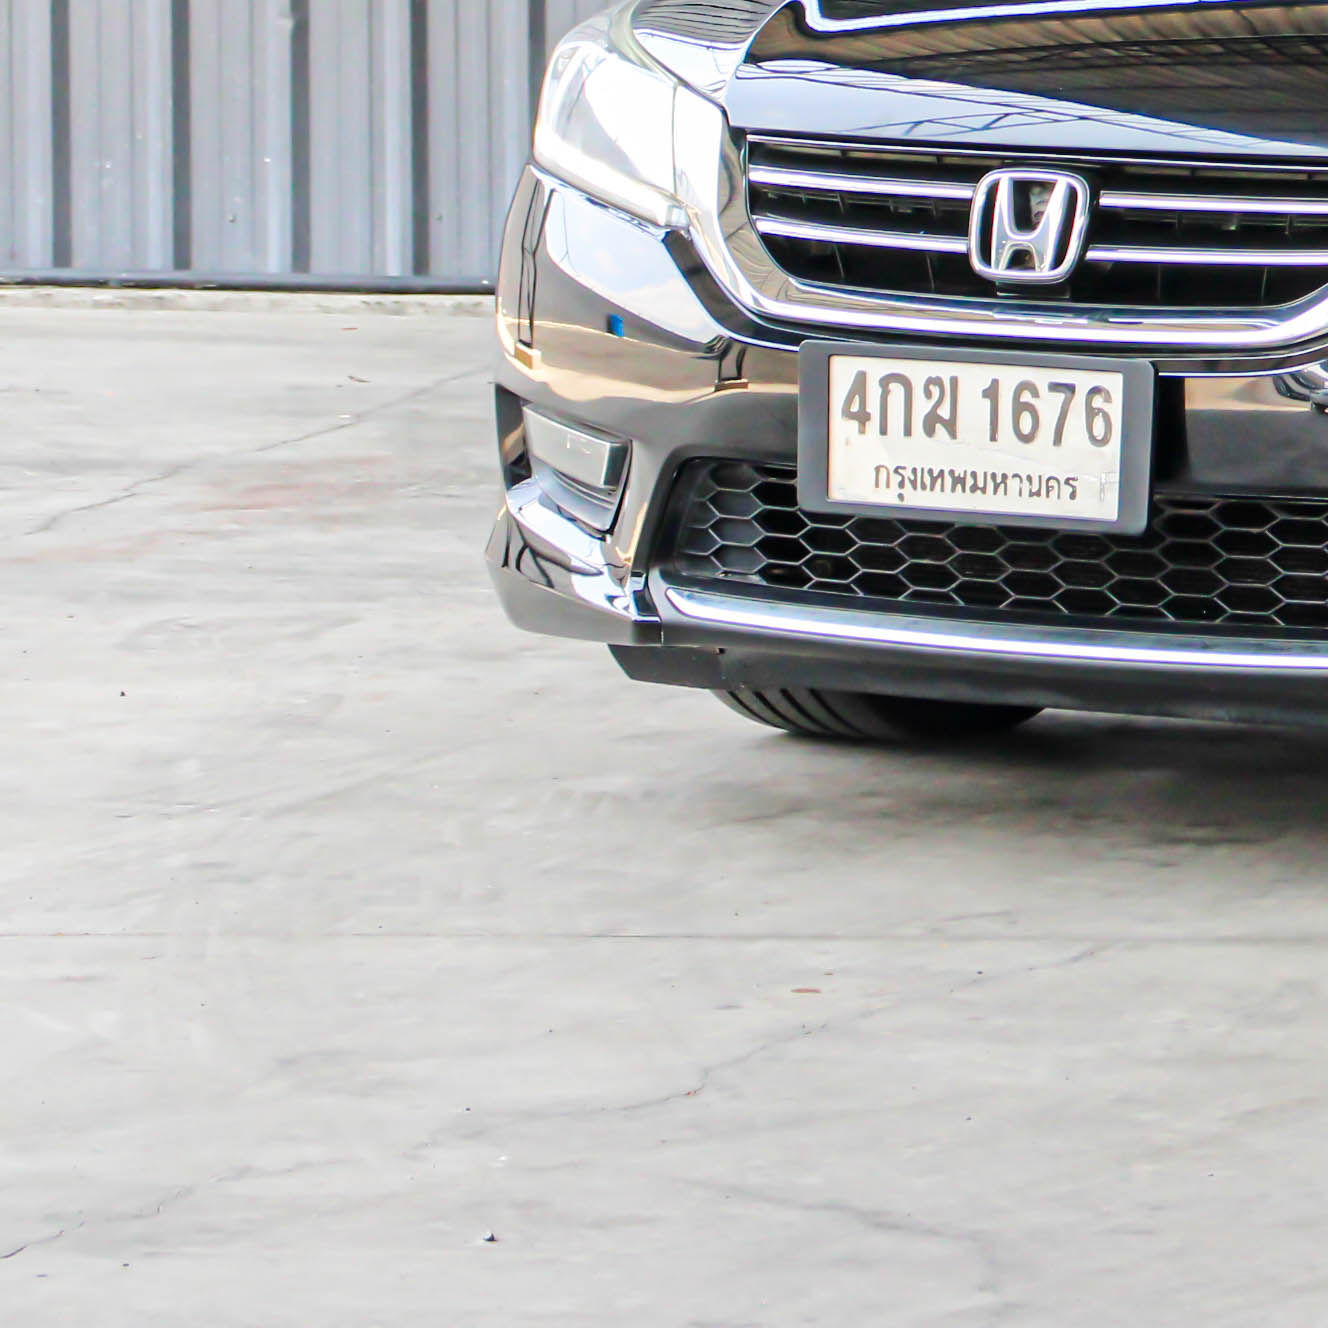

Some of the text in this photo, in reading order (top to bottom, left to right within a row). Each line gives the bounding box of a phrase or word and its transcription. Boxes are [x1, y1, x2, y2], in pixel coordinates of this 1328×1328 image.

[841, 370, 1114, 448] 4กฆ 1676
[873, 464, 1080, 502] กรุงเทพมหานคร
